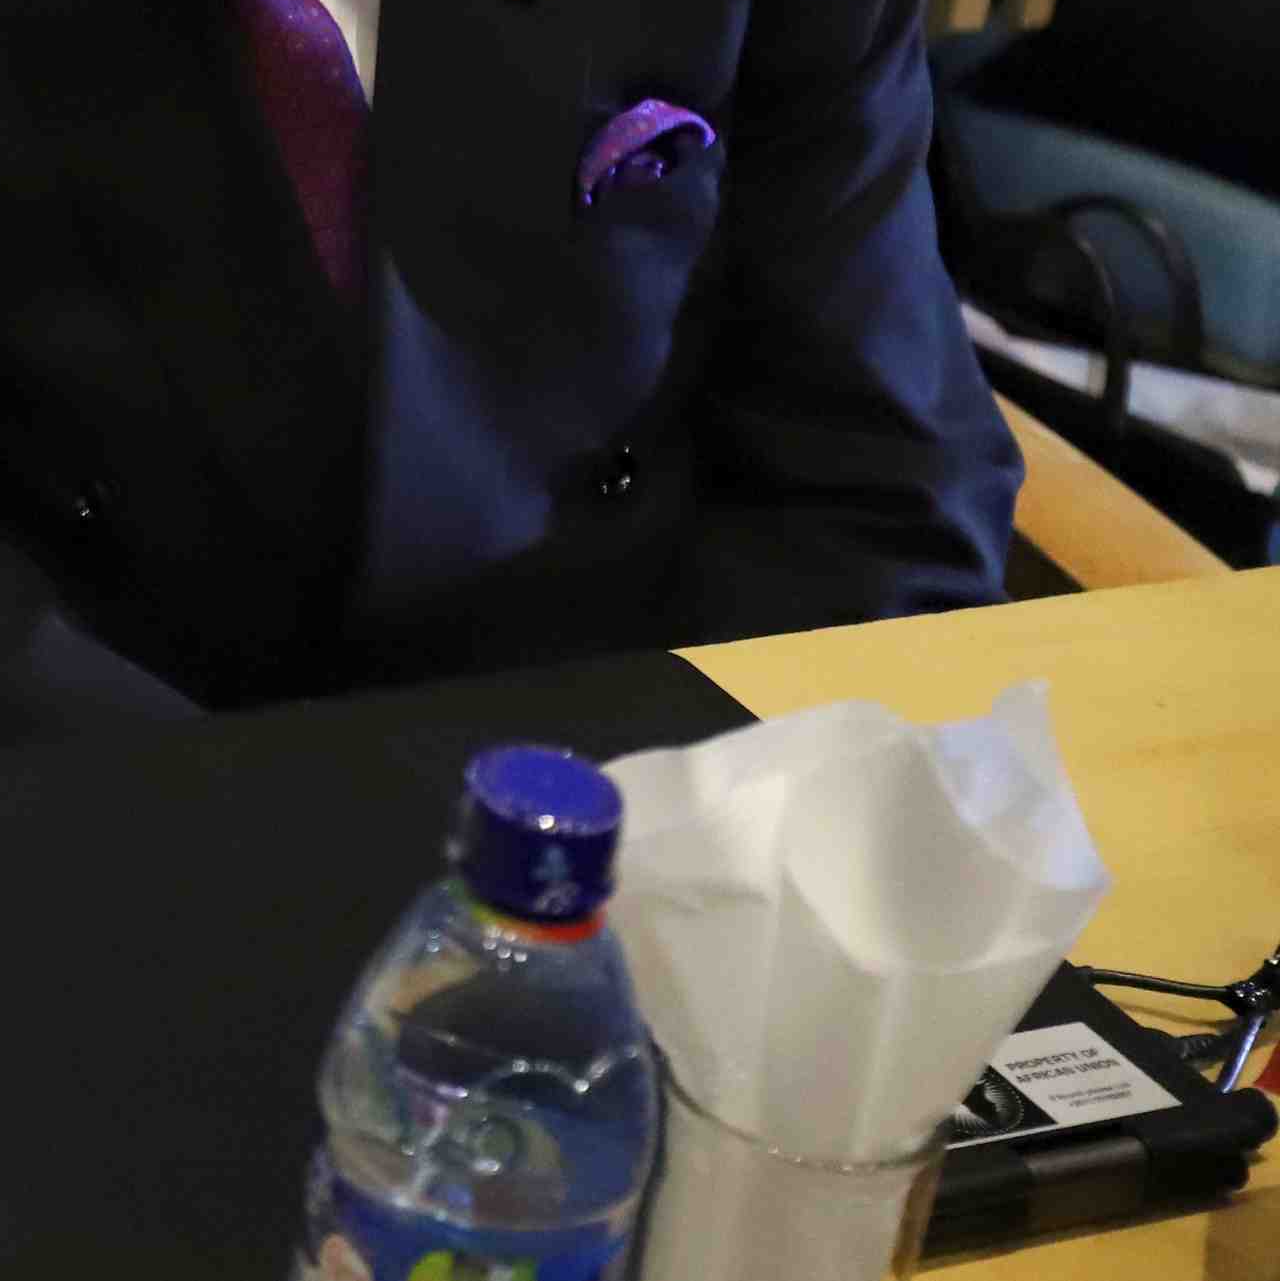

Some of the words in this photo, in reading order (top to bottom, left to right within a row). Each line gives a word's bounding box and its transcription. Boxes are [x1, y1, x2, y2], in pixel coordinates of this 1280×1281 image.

[1005, 1050, 1077, 1071] PROPERTY
[1080, 1047, 1099, 1062] OF
[1015, 1065, 1075, 1083] AFRICAN
[1078, 1057, 1121, 1073] UNION
